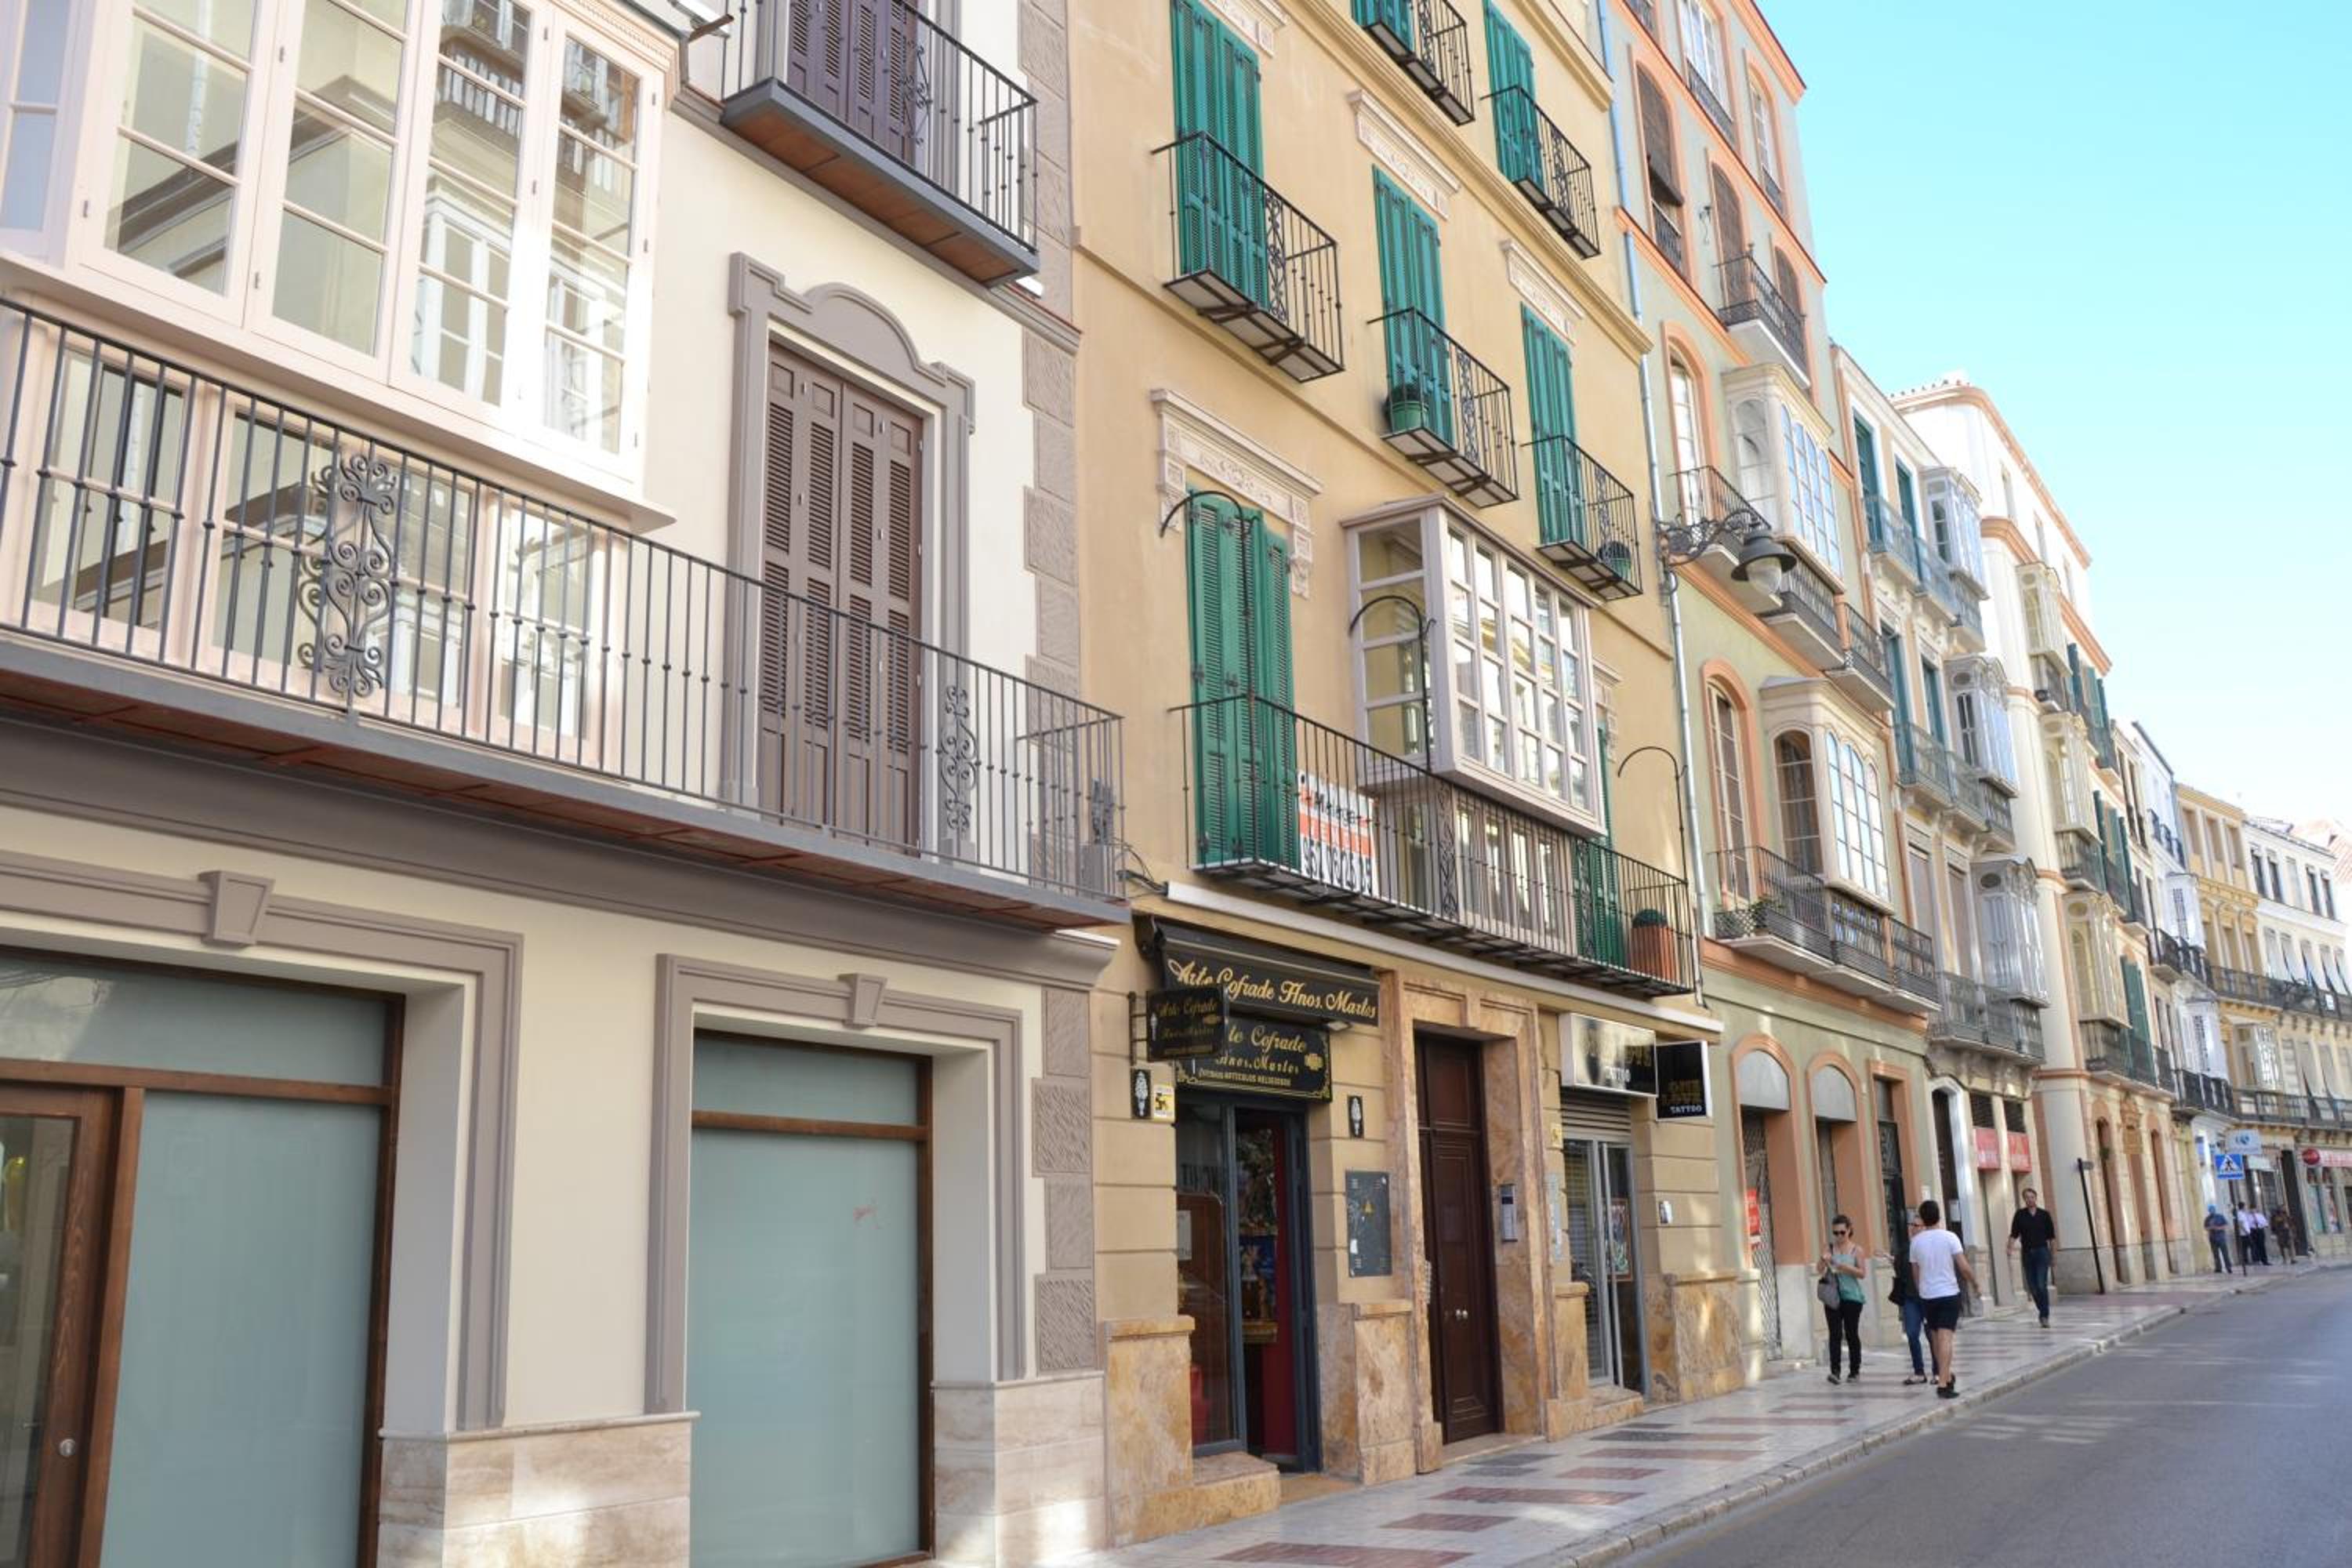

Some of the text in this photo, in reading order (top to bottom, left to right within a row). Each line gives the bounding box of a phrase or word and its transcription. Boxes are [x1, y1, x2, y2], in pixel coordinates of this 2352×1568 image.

[1168, 959, 1214, 985] Arte
[1216, 967, 1275, 1002] Cofrade
[1250, 1025, 1307, 1053] Cofrade
